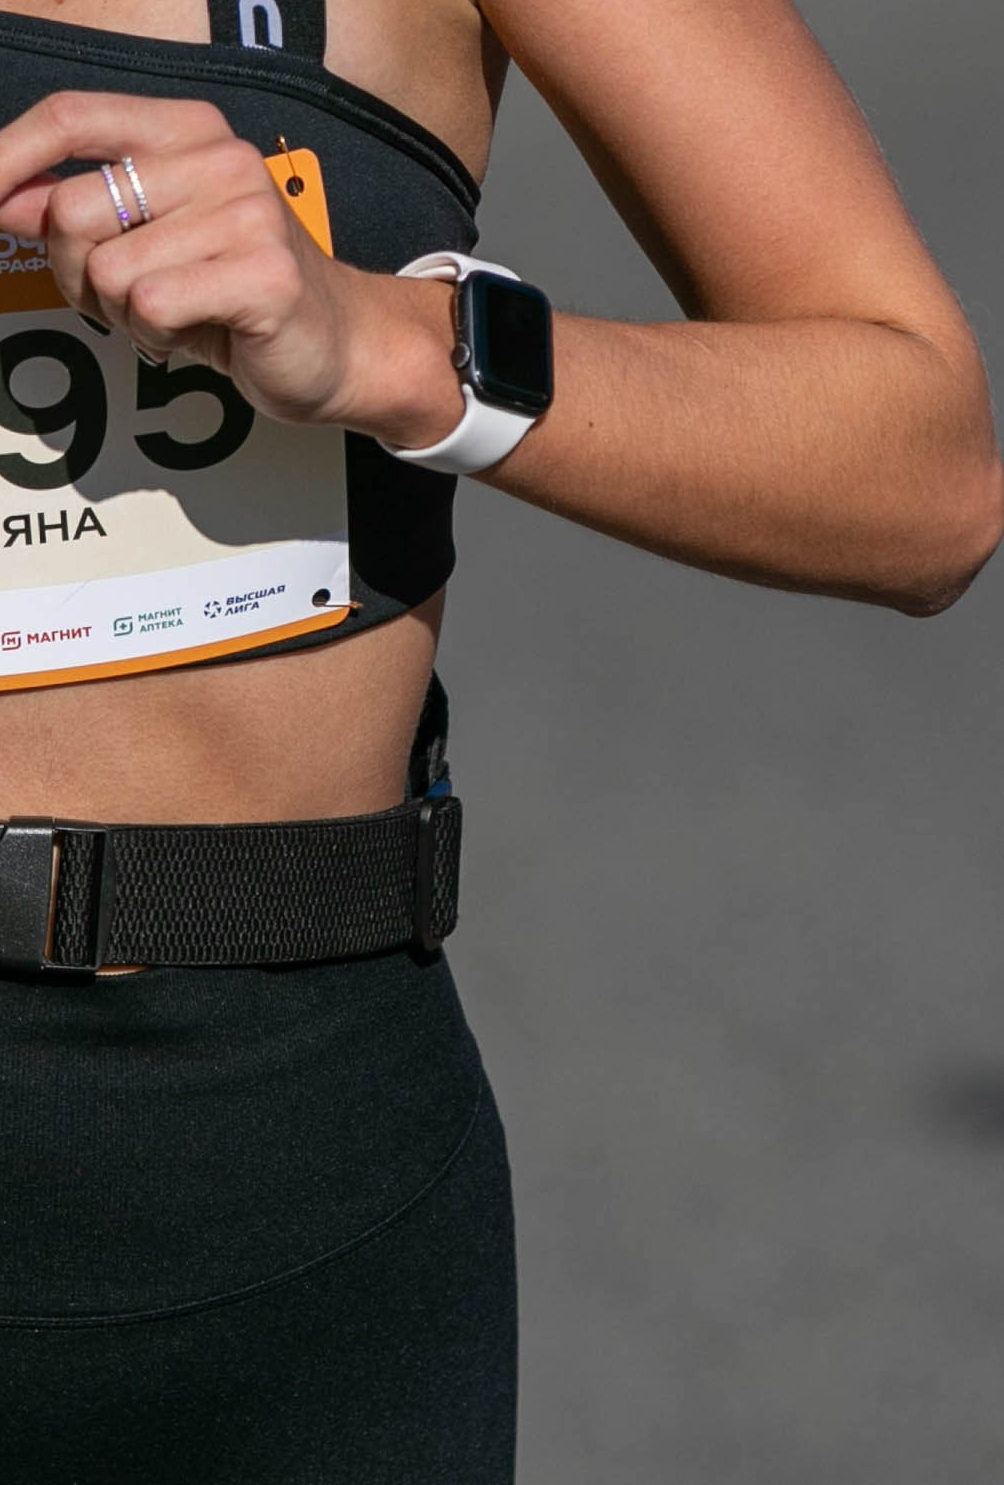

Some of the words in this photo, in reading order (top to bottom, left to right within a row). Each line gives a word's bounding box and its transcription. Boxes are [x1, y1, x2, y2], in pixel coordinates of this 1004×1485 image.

[225, 584, 287, 606] ВЫСШАЯ
[137, 606, 183, 623] МАГНИТ
[224, 600, 261, 616] ЛИГА
[139, 618, 184, 633] АПТЕКА
[26, 626, 93, 645] МАГНИТ
